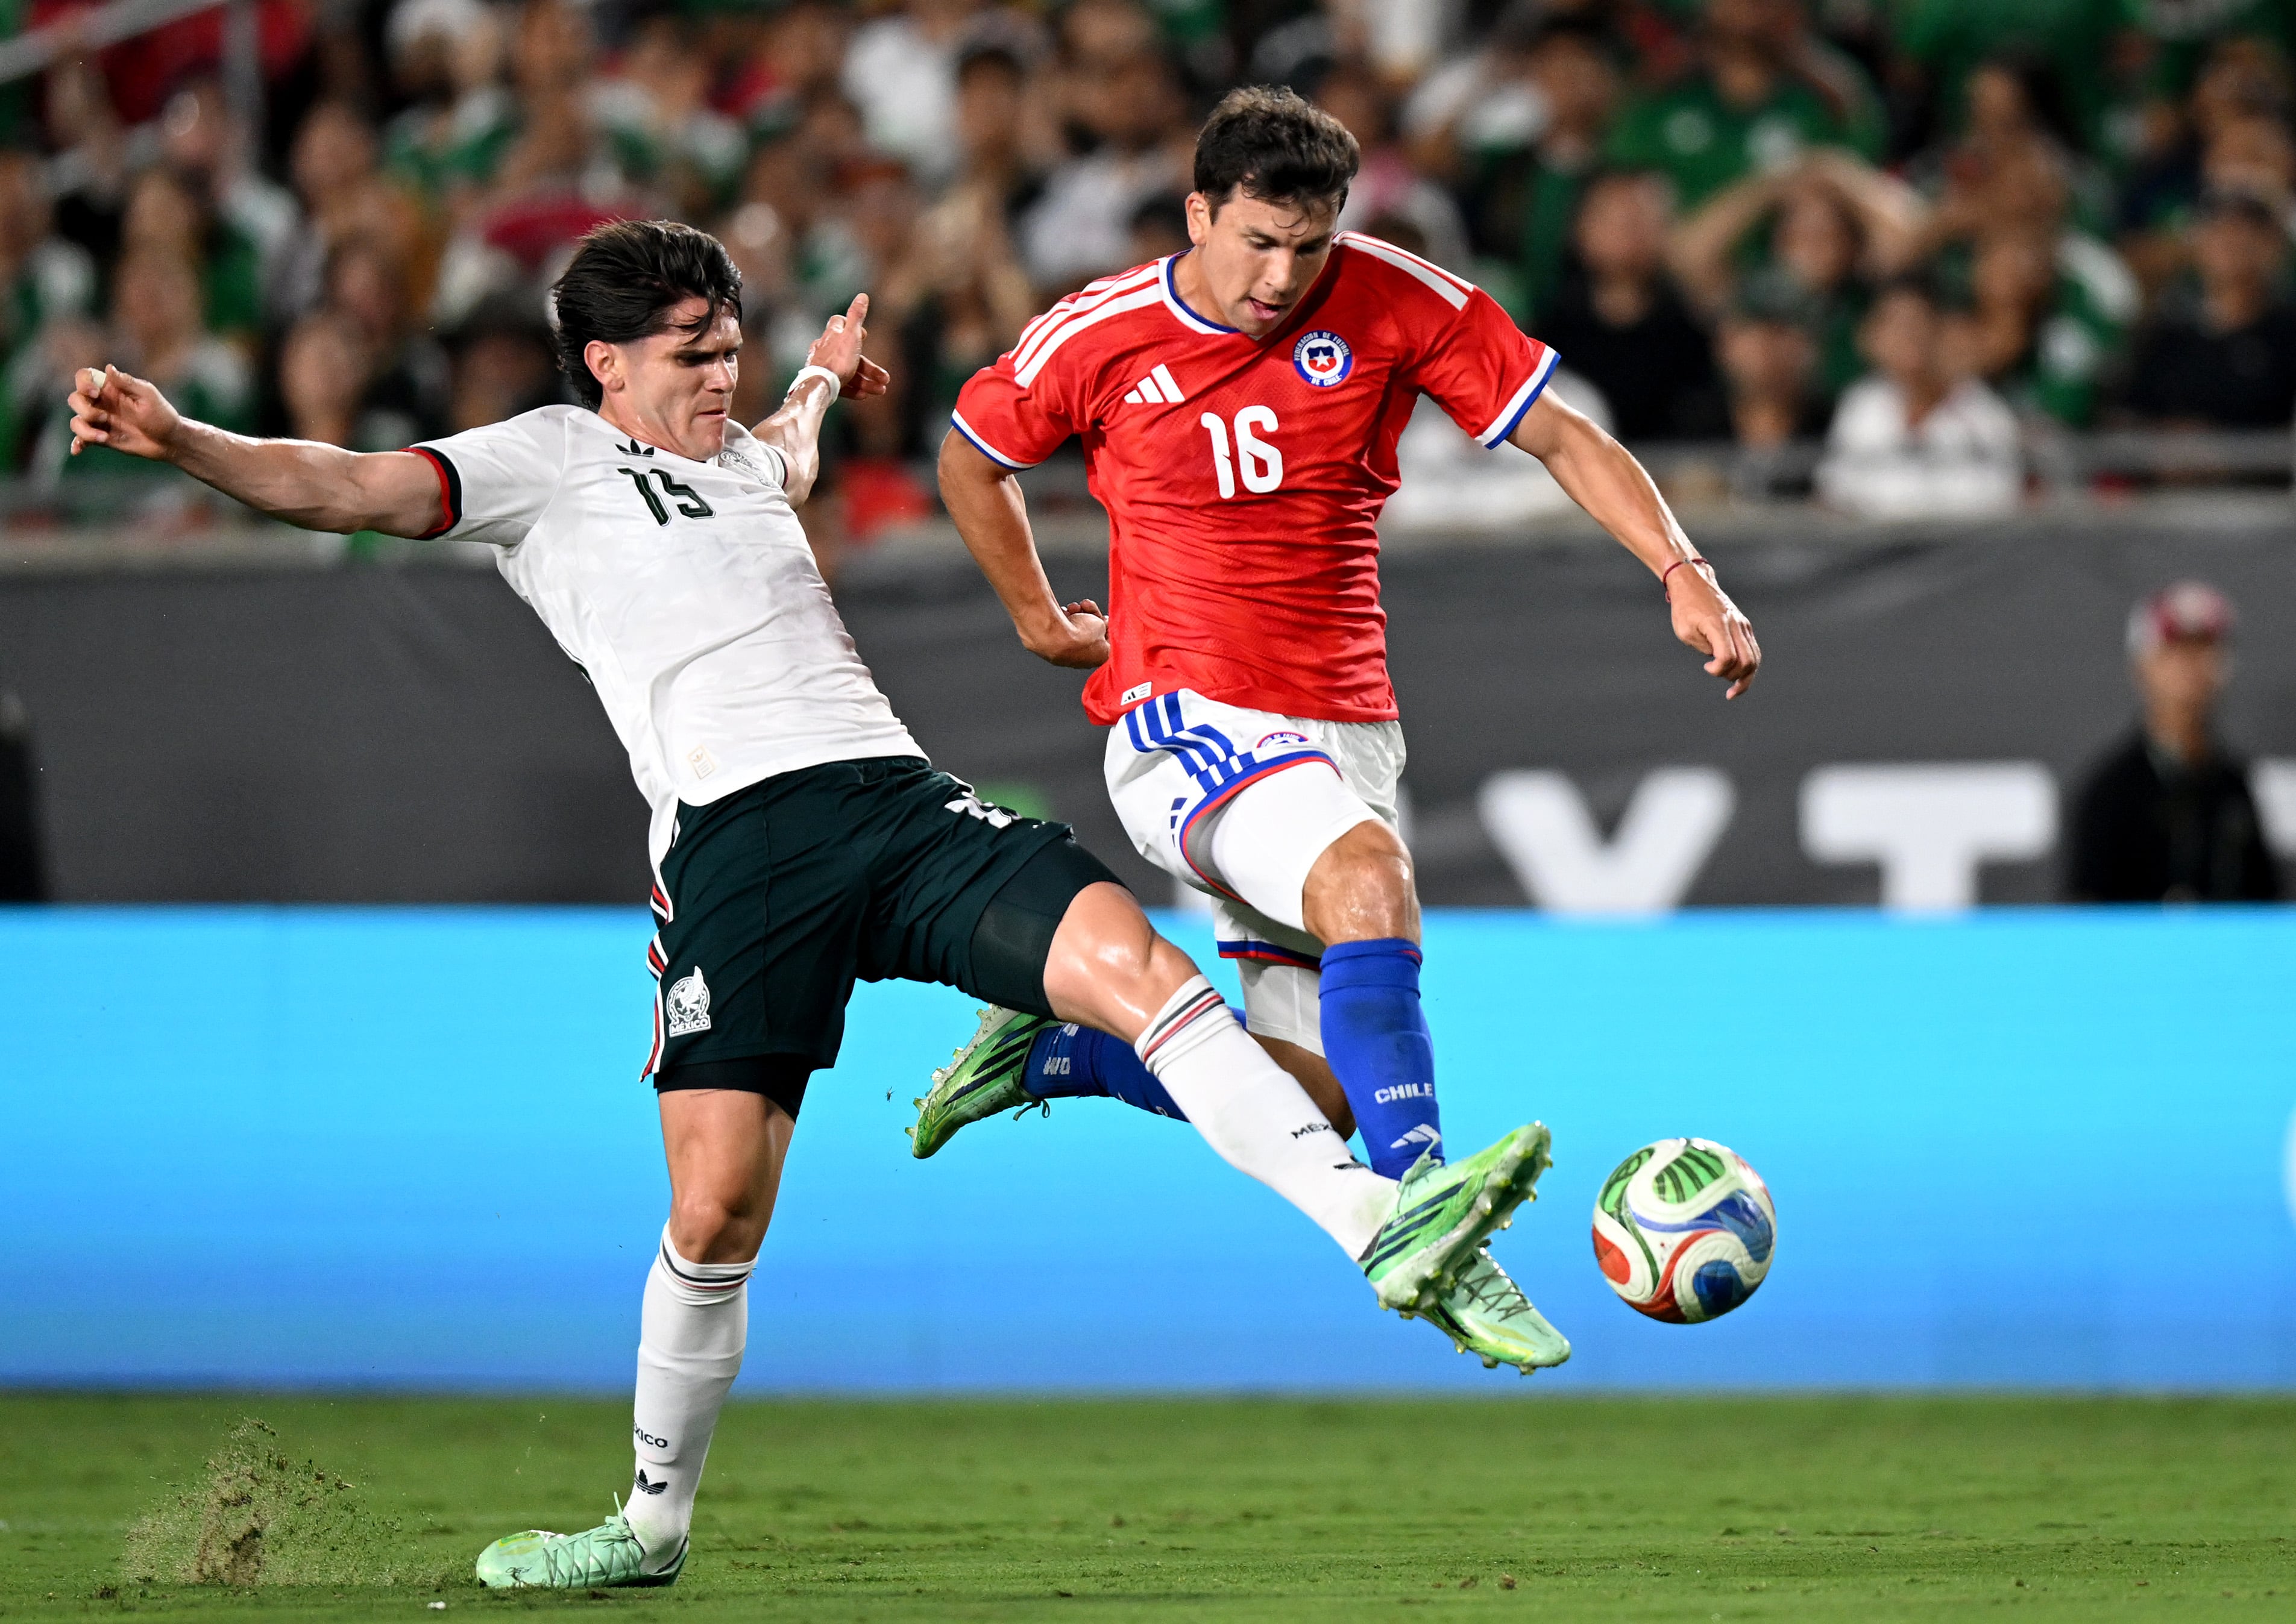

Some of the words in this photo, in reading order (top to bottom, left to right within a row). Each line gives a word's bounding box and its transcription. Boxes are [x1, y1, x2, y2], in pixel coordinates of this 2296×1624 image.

[1333, 336, 1350, 357] FUTBOL
[1310, 377, 1321, 386] DE
[1323, 374, 1342, 386] CHILE
[1200, 405, 1283, 499] 16
[1374, 1082, 1433, 1104] CHILE
[634, 1422, 668, 1448] XICO
